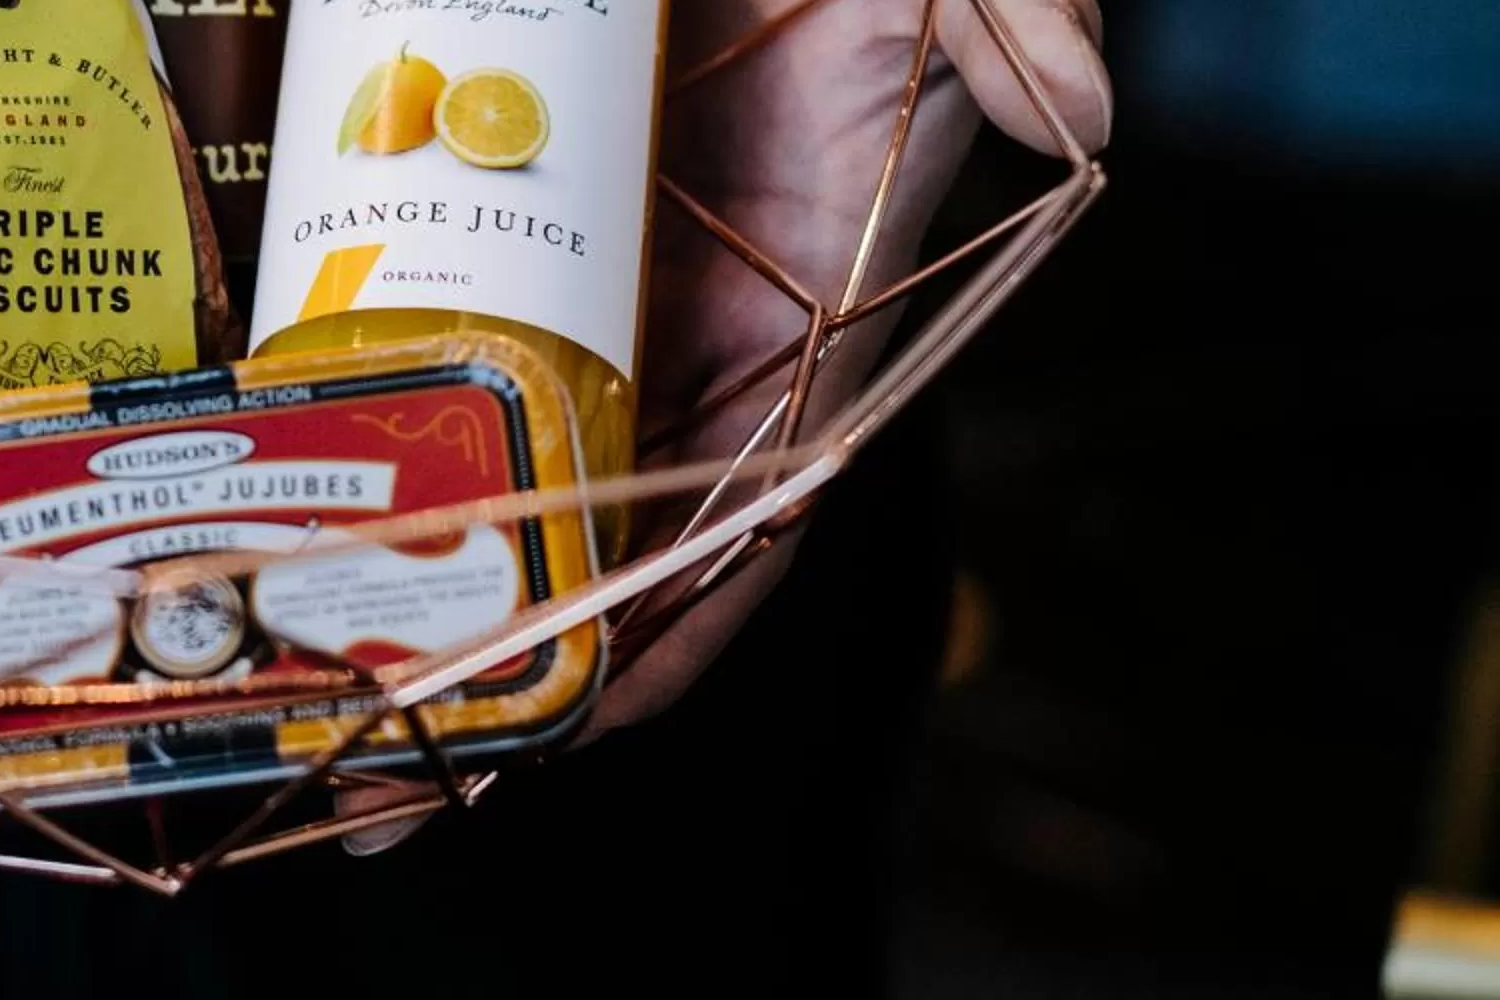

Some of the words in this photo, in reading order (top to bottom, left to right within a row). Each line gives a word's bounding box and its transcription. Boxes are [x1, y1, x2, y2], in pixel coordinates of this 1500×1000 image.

[48, 53, 63, 67] &
[76, 59, 152, 131] BUTLER
[3, 164, 66, 194] Finest
[294, 200, 449, 244] ORANGE
[468, 205, 587, 257] JUICE
[34, 248, 163, 276] CHUNK
[382, 270, 474, 286] ORGANIC
[20, 412, 111, 437] GRADUAL
[117, 391, 235, 424] DISSOLVING
[238, 386, 312, 409] ACTION
[103, 439, 241, 471] HUDSON'S
[219, 474, 365, 502] JUJUBES
[128, 528, 239, 557] CLASSIC
